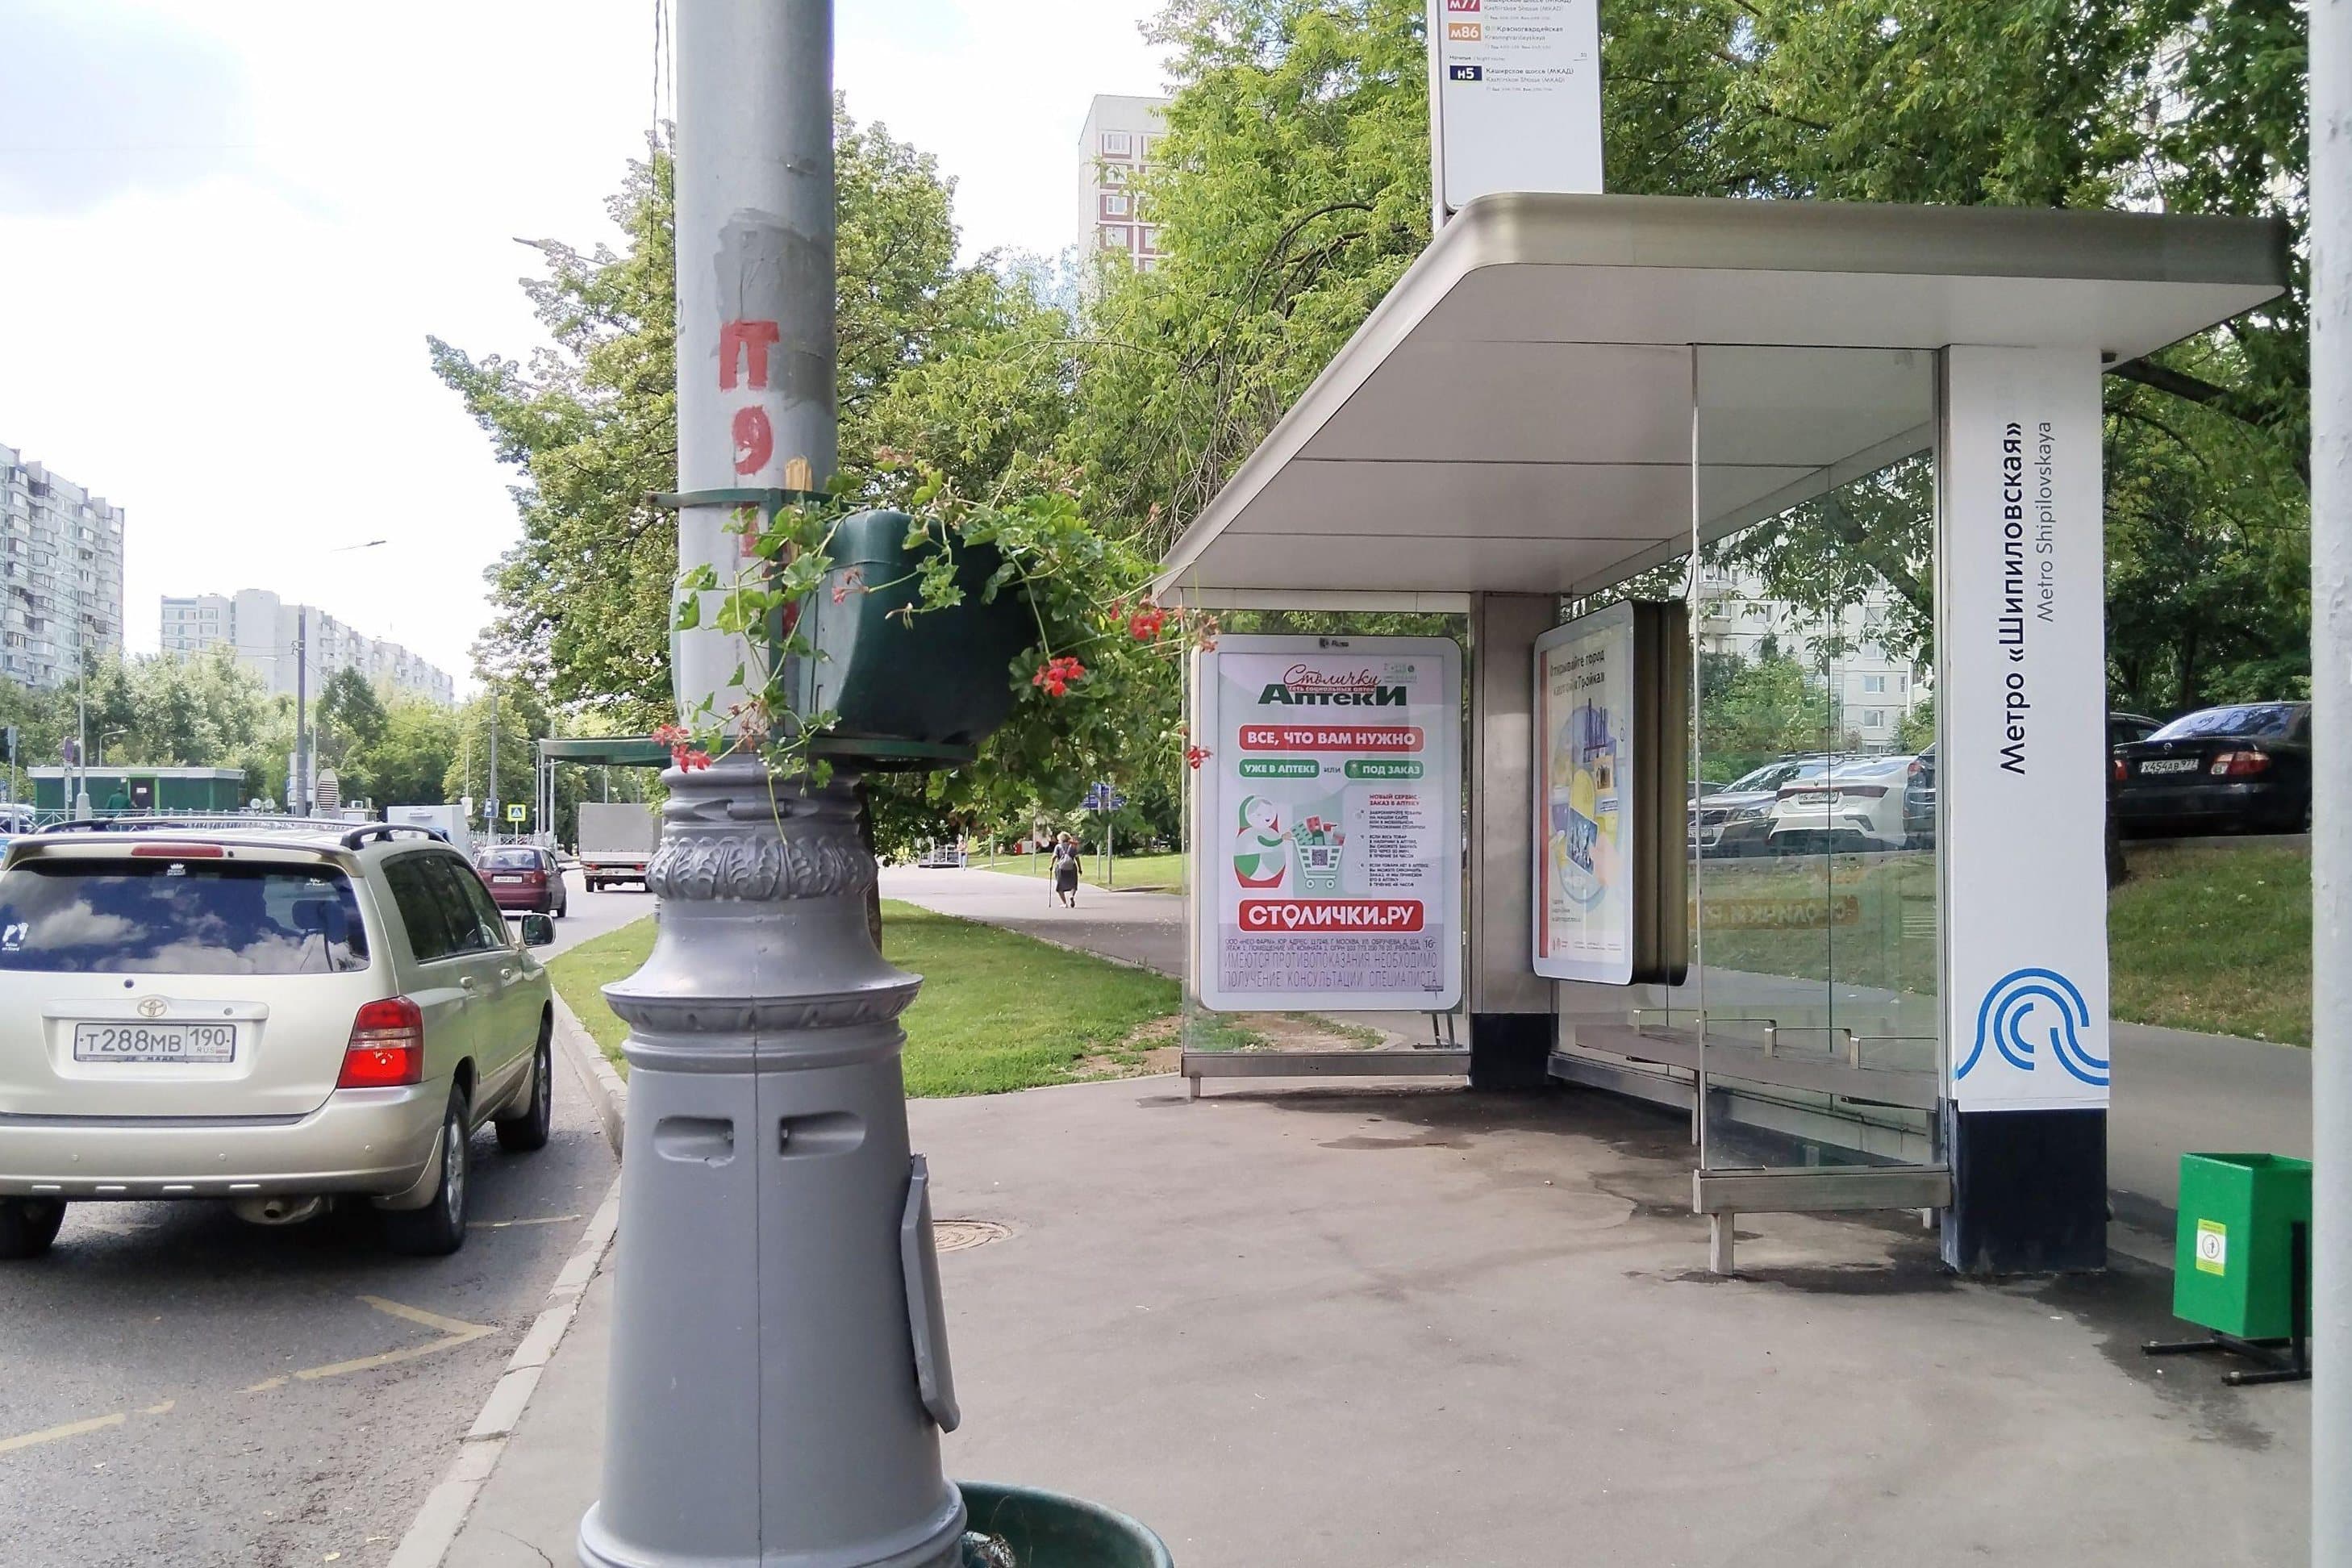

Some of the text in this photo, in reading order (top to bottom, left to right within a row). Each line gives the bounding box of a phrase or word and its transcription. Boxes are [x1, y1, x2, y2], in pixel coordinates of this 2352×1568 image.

[1450, 26, 1478, 38] м86
[2034, 422, 2055, 623] Metro Shipilovskaya
[1998, 422, 2030, 775] Метро «Шипиловская»
[1283, 664, 1382, 686] Столички
[1247, 731, 1416, 746] ВСЕ, ЧТО ВАМ НУЖНО
[1244, 764, 1316, 774] УЖЕ В АПТЕКЕ
[1362, 766, 1420, 776] ПОД ЗАКАЗ
[1249, 903, 1415, 929] СТОЛИЧКИ.РУ
[190, 1028, 226, 1046] 190
